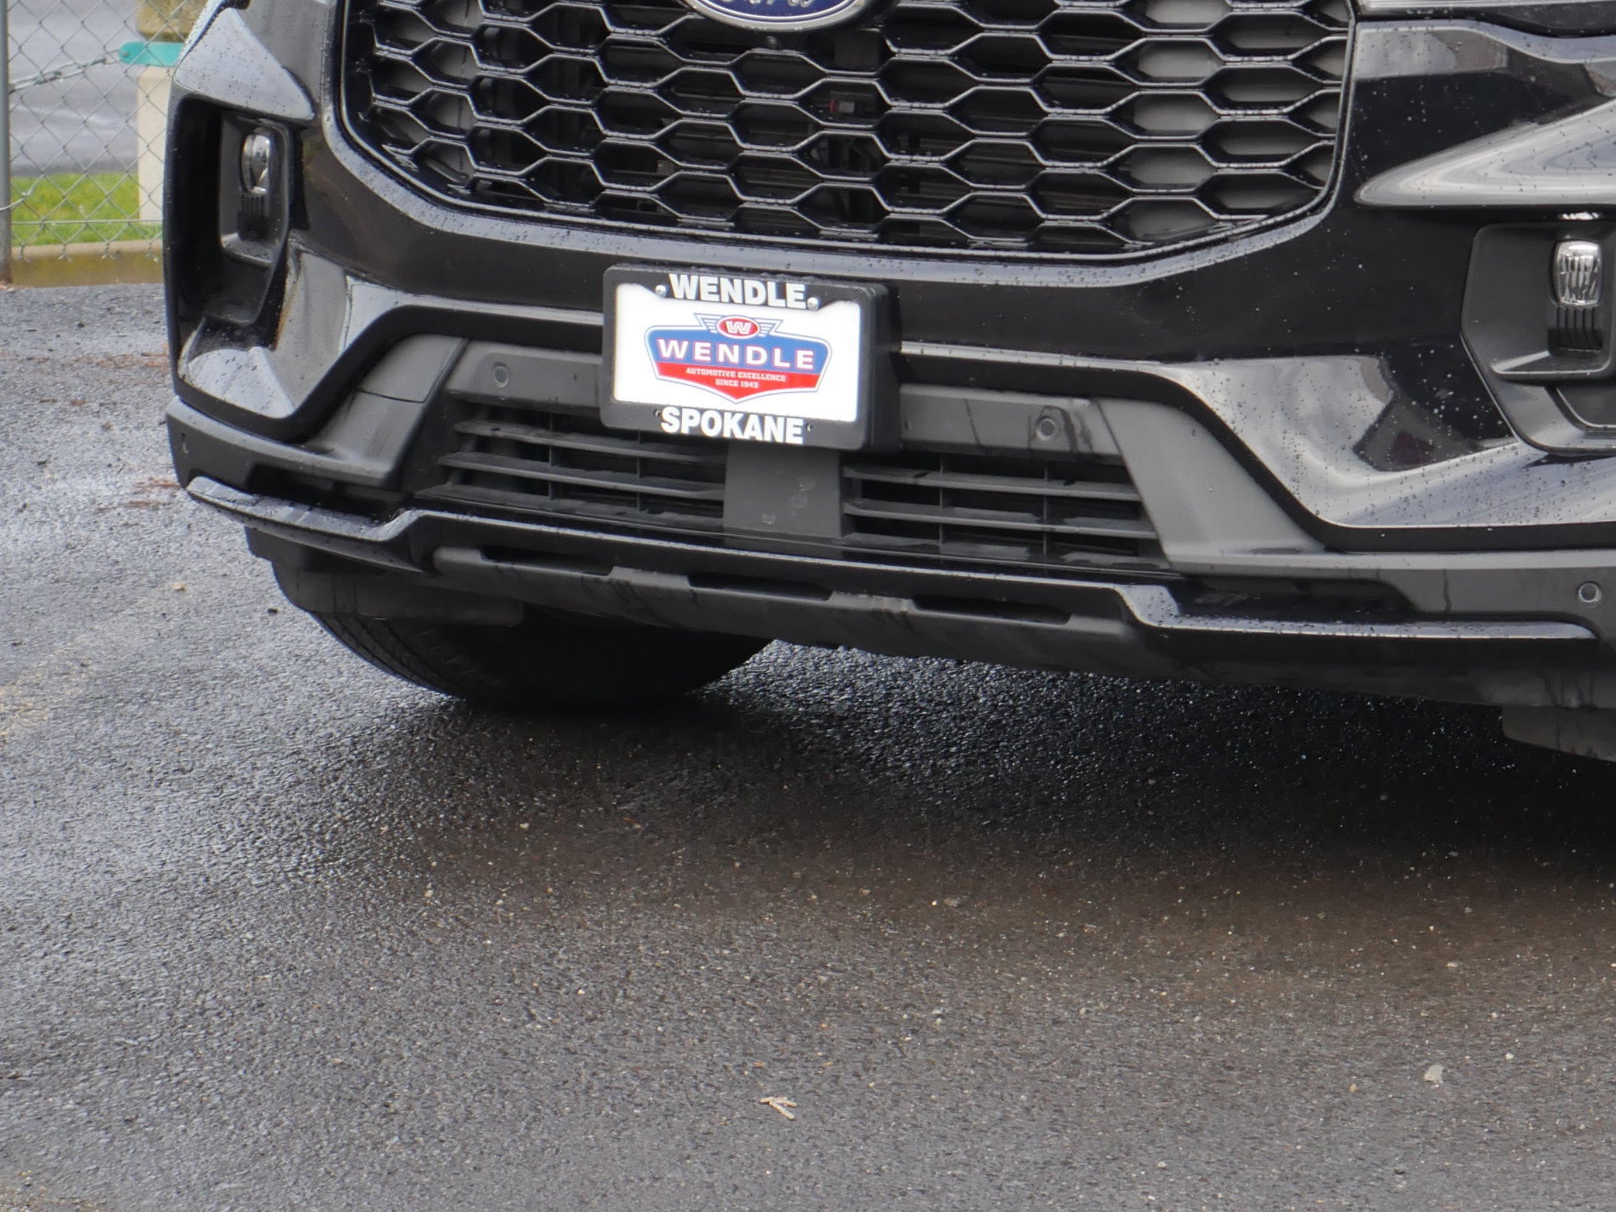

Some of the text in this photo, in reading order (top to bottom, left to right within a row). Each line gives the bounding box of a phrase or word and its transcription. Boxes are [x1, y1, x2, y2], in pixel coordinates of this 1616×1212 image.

[668, 274, 807, 310] WENDLE
[725, 319, 752, 335] W
[657, 338, 814, 370] WENDLE
[686, 367, 787, 382] AUTOMOTIVE EXCELLENCE
[715, 378, 739, 387] SINCE
[661, 405, 804, 445] SPOKANE
